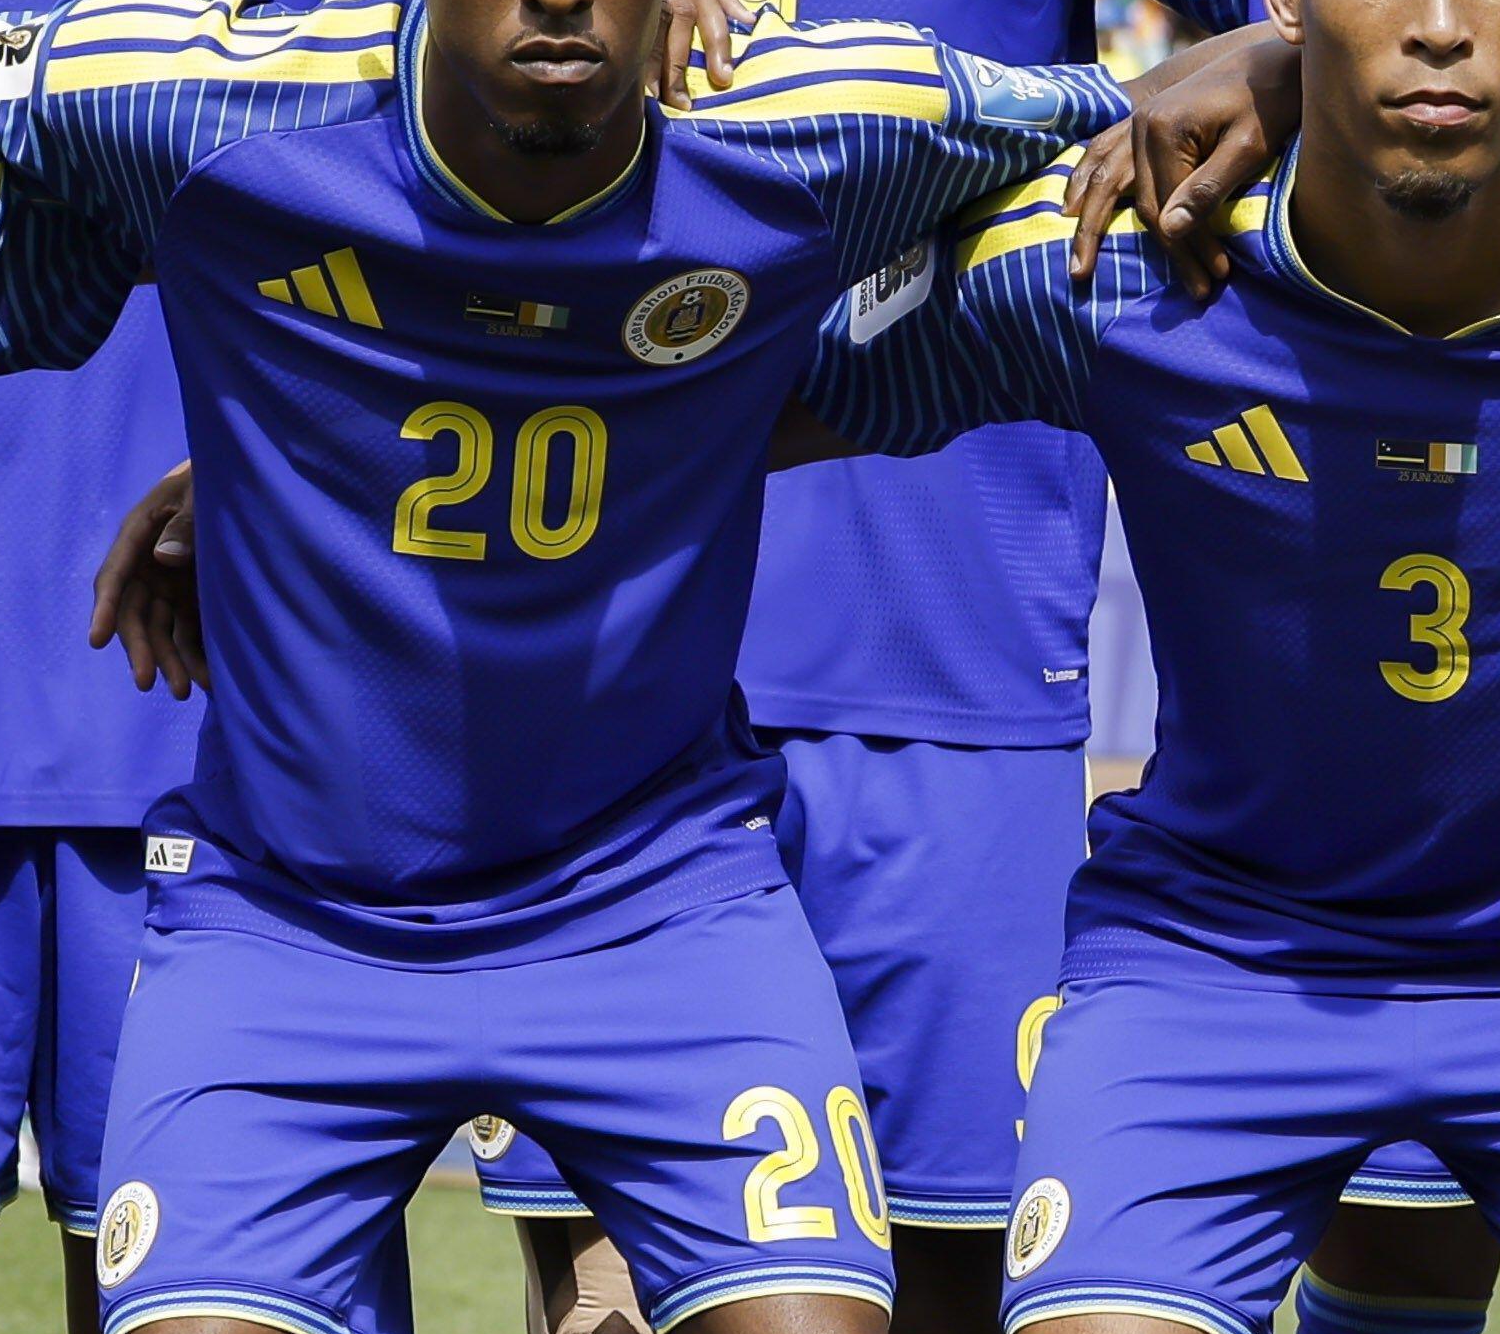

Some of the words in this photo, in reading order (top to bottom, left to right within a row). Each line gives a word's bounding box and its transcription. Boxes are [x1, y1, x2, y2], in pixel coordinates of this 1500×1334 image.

[629, 282, 679, 358] Federashon
[392, 400, 609, 561] 20
[1378, 552, 1473, 704] 3
[721, 1085, 892, 1252] 20
